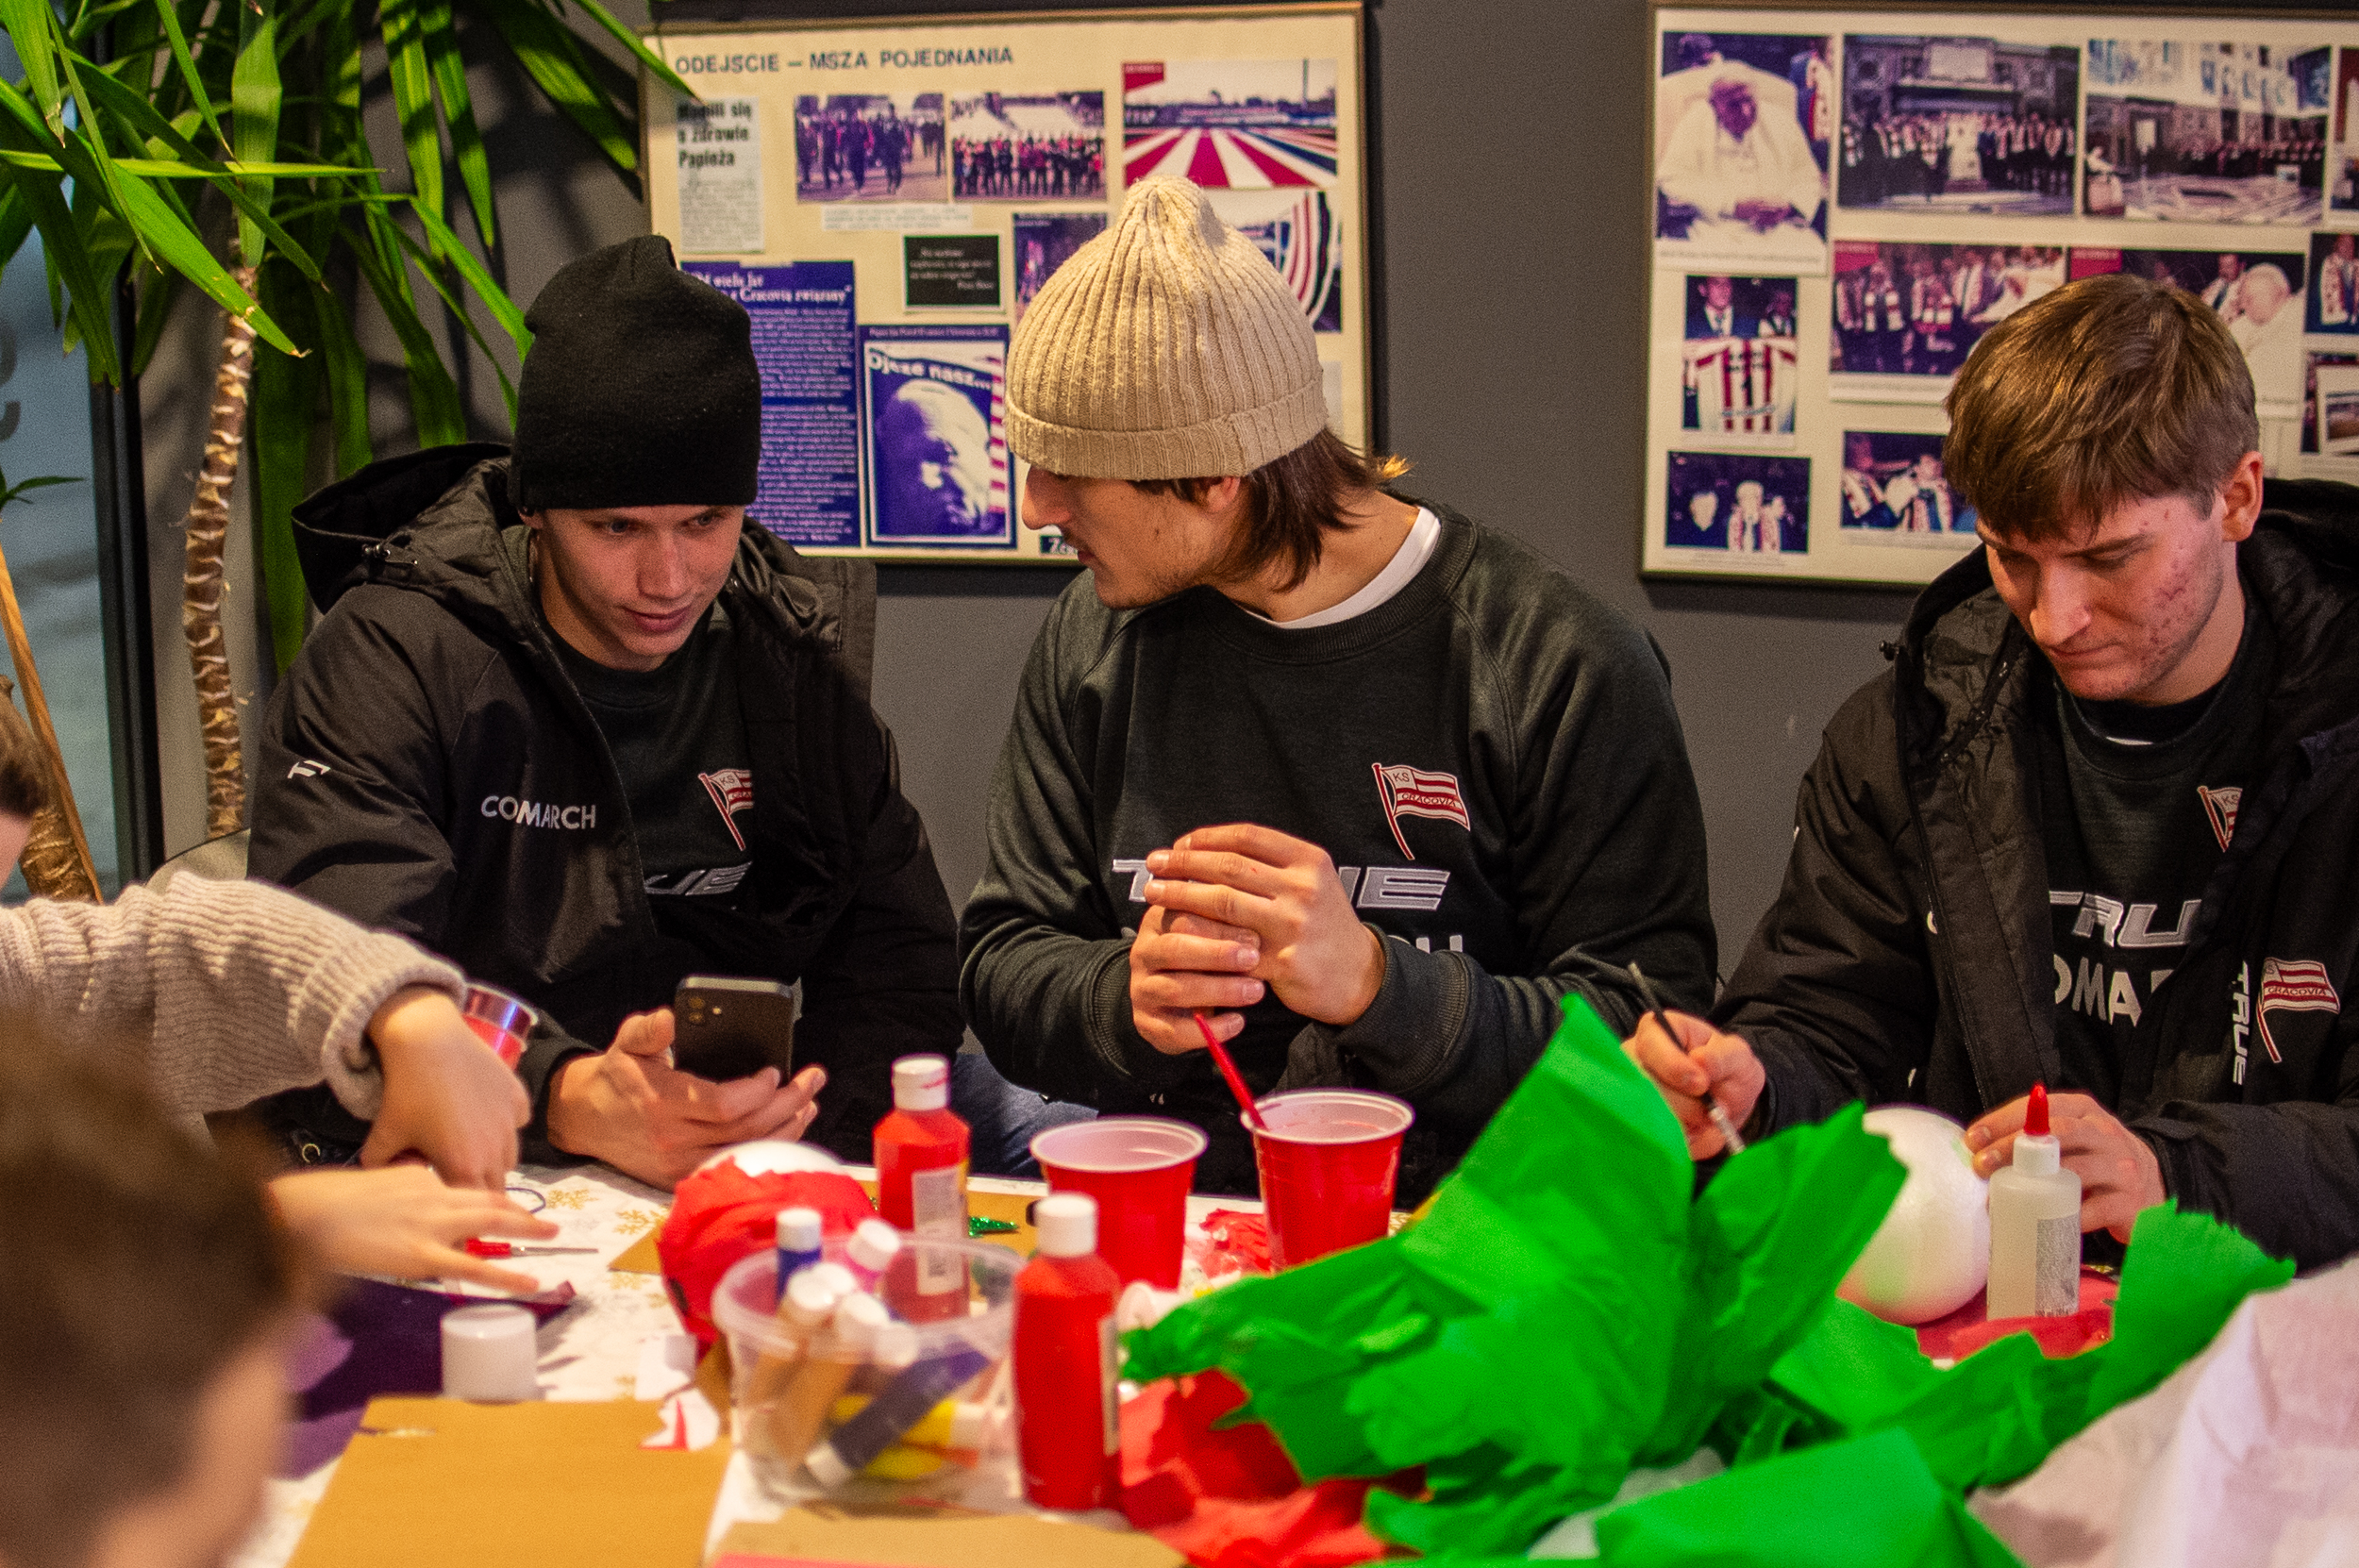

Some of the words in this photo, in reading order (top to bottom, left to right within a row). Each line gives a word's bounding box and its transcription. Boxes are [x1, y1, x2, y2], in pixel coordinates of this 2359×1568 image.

[810, 50, 868, 71] MSZA
[879, 46, 1014, 68] POJEDNANIA
[718, 775, 735, 786] KS
[1392, 772, 1411, 783] KS
[1401, 792, 1457, 808] CRACOVIA
[480, 795, 596, 829] COMARCH
[2267, 985, 2328, 996] CRACOVIA
